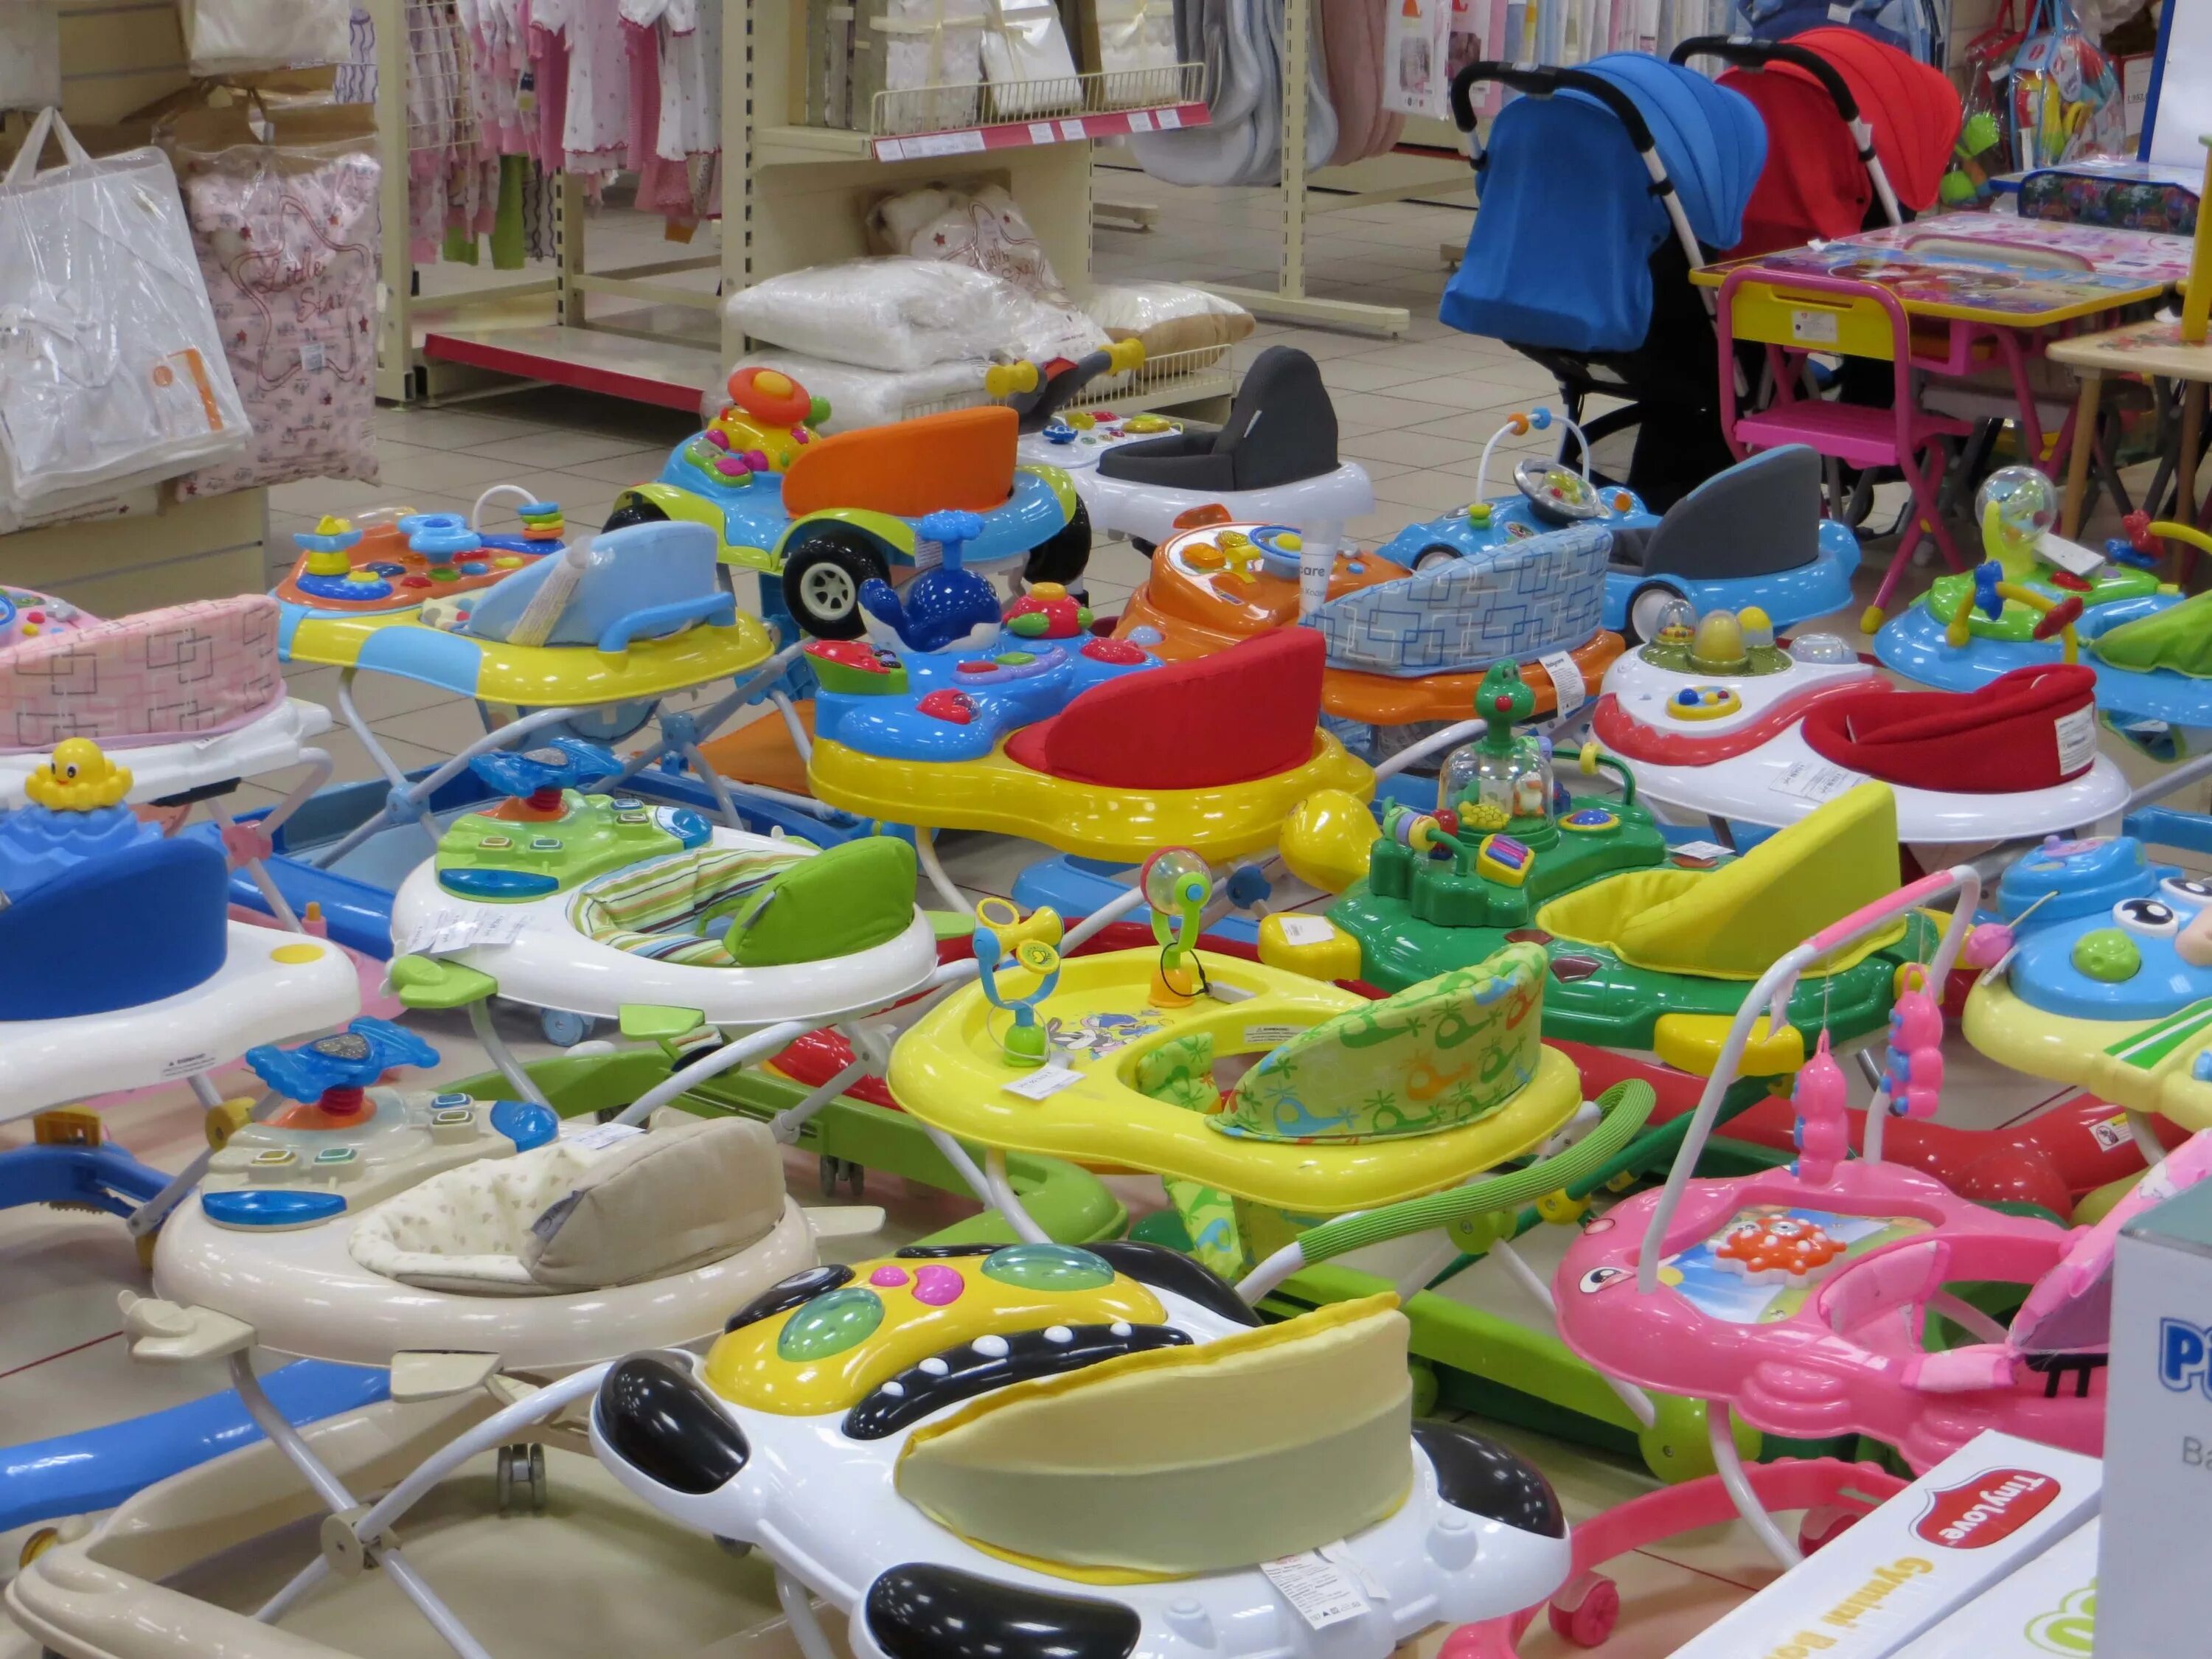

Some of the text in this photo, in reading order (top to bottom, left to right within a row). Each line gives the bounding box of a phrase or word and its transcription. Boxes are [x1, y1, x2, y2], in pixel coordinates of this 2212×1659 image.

[252, 247, 322, 294] Little
[296, 288, 343, 322] Star
[1939, 1475, 2046, 1540] Tiny Love
